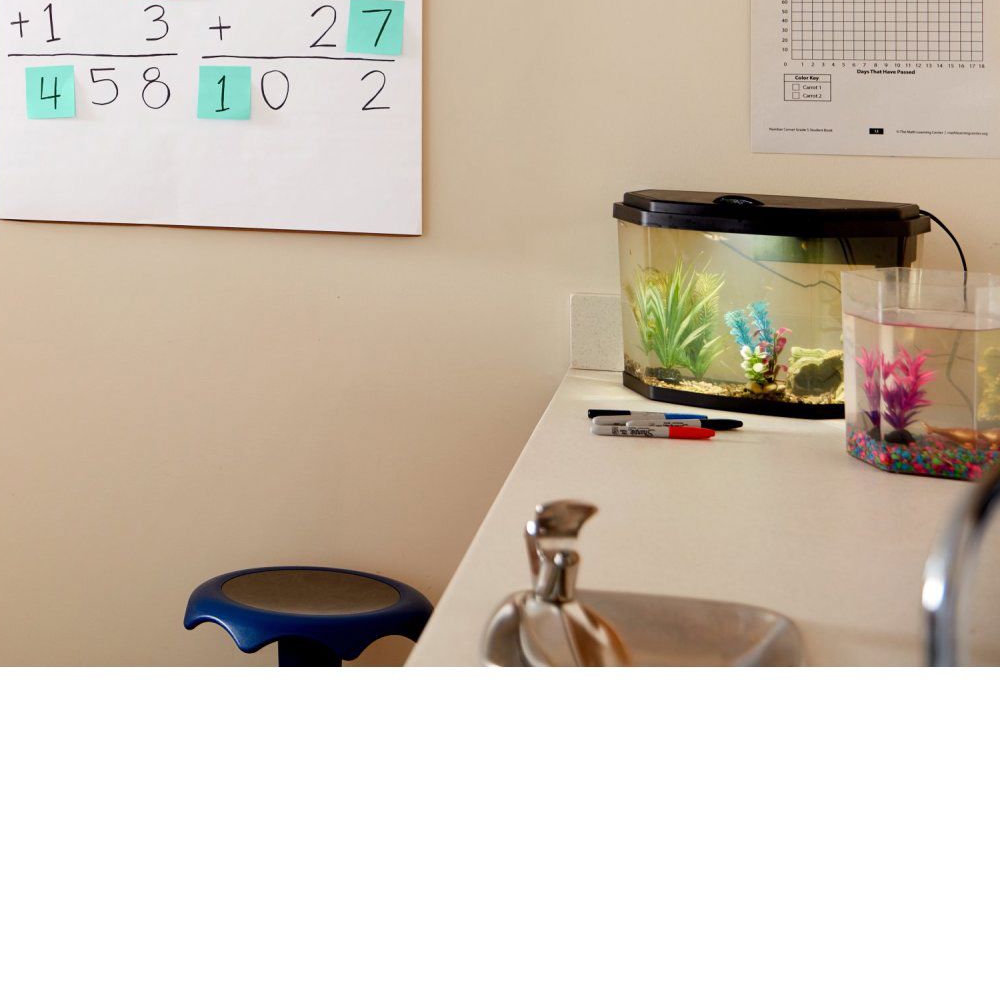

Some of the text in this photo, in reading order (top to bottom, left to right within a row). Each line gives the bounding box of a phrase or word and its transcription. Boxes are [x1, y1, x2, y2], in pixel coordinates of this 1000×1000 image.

[144, 4, 169, 42] 3
[310, 5, 337, 49] 2
[362, 8, 393, 48] 7
[40, 76, 61, 110] 4
[214, 70, 391, 113] 1 0 2
